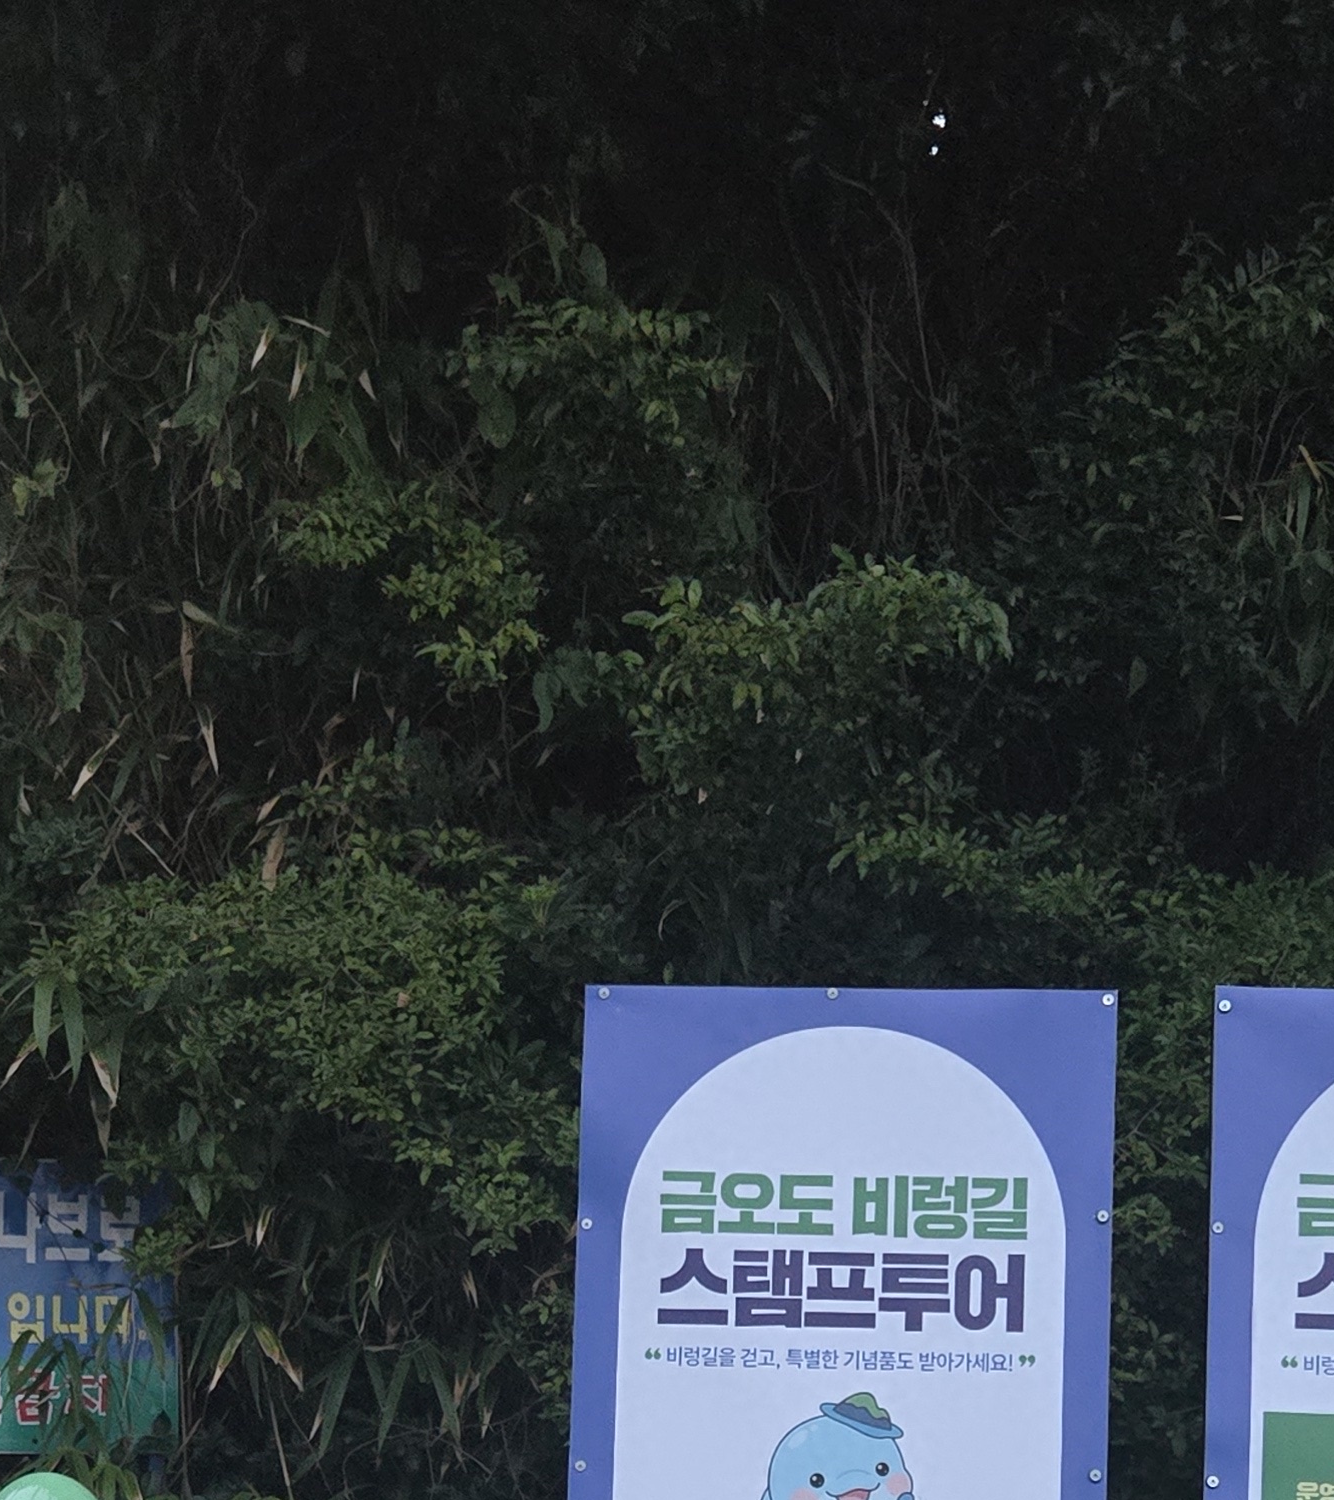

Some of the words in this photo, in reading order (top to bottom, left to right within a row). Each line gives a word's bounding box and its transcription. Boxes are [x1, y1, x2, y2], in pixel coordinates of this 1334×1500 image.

[660, 1170, 834, 1236] 금오도
[853, 1174, 1028, 1240] 비렁길
[657, 1247, 1025, 1332] 스탬프투어
[667, 1347, 735, 1366] 비렁길을
[741, 1350, 780, 1369] 걷고,
[786, 1350, 839, 1369] 특별한
[844, 1350, 913, 1370] 기념품도
[919, 1352, 1012, 1372] 받아가세요!
